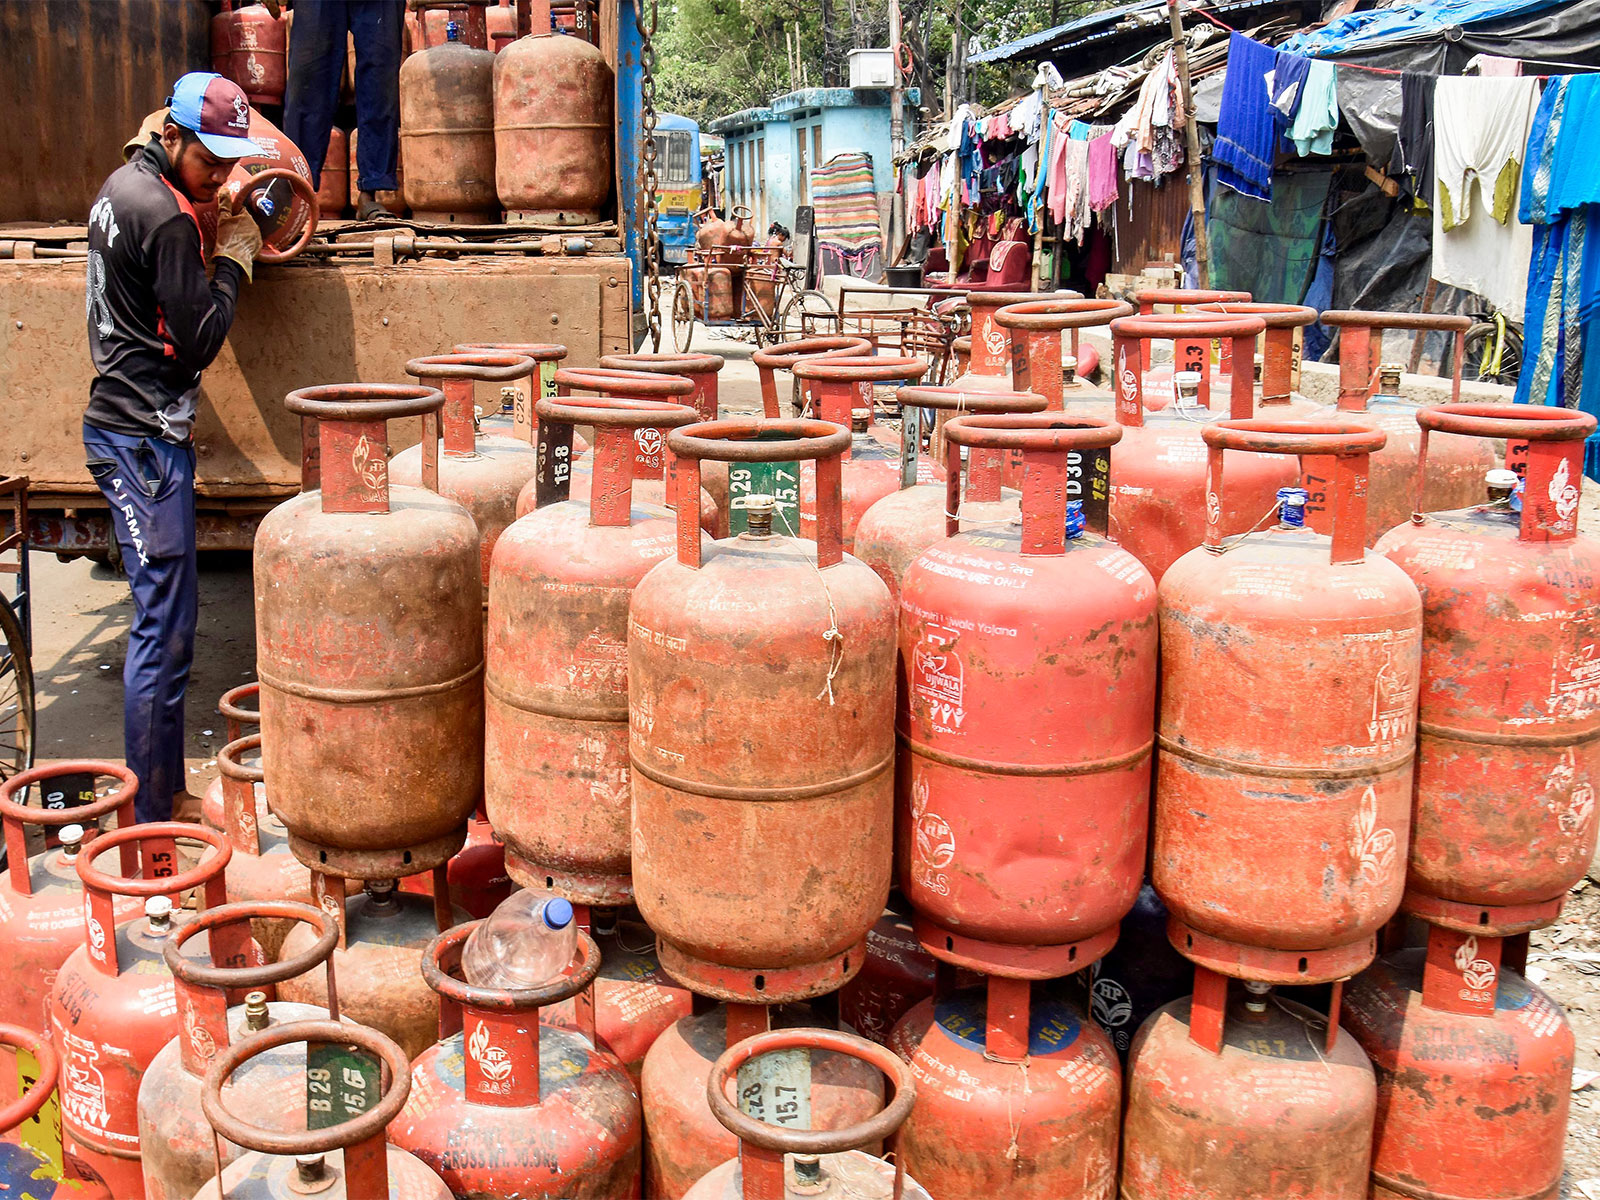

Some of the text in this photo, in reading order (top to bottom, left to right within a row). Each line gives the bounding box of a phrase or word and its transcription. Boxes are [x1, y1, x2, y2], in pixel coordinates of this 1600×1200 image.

[516, 392, 525, 424] C26
[644, 431, 658, 441] HP
[370, 463, 386, 473] HP
[554, 445, 570, 486] 15.8
[1092, 457, 1110, 501] 15.6
[775, 469, 798, 511] 15.7
[1306, 474, 1327, 514] 15.7
[977, 622, 1018, 637] Yojana
[46, 791, 66, 810] 30
[151, 852, 173, 878] 5.5
[1100, 982, 1123, 1002] HP
[486, 1050, 507, 1061] HP
[478, 1080, 512, 1095] GAS
[774, 1085, 799, 1124] 15.7
[442, 1150, 486, 1171] GROSS
